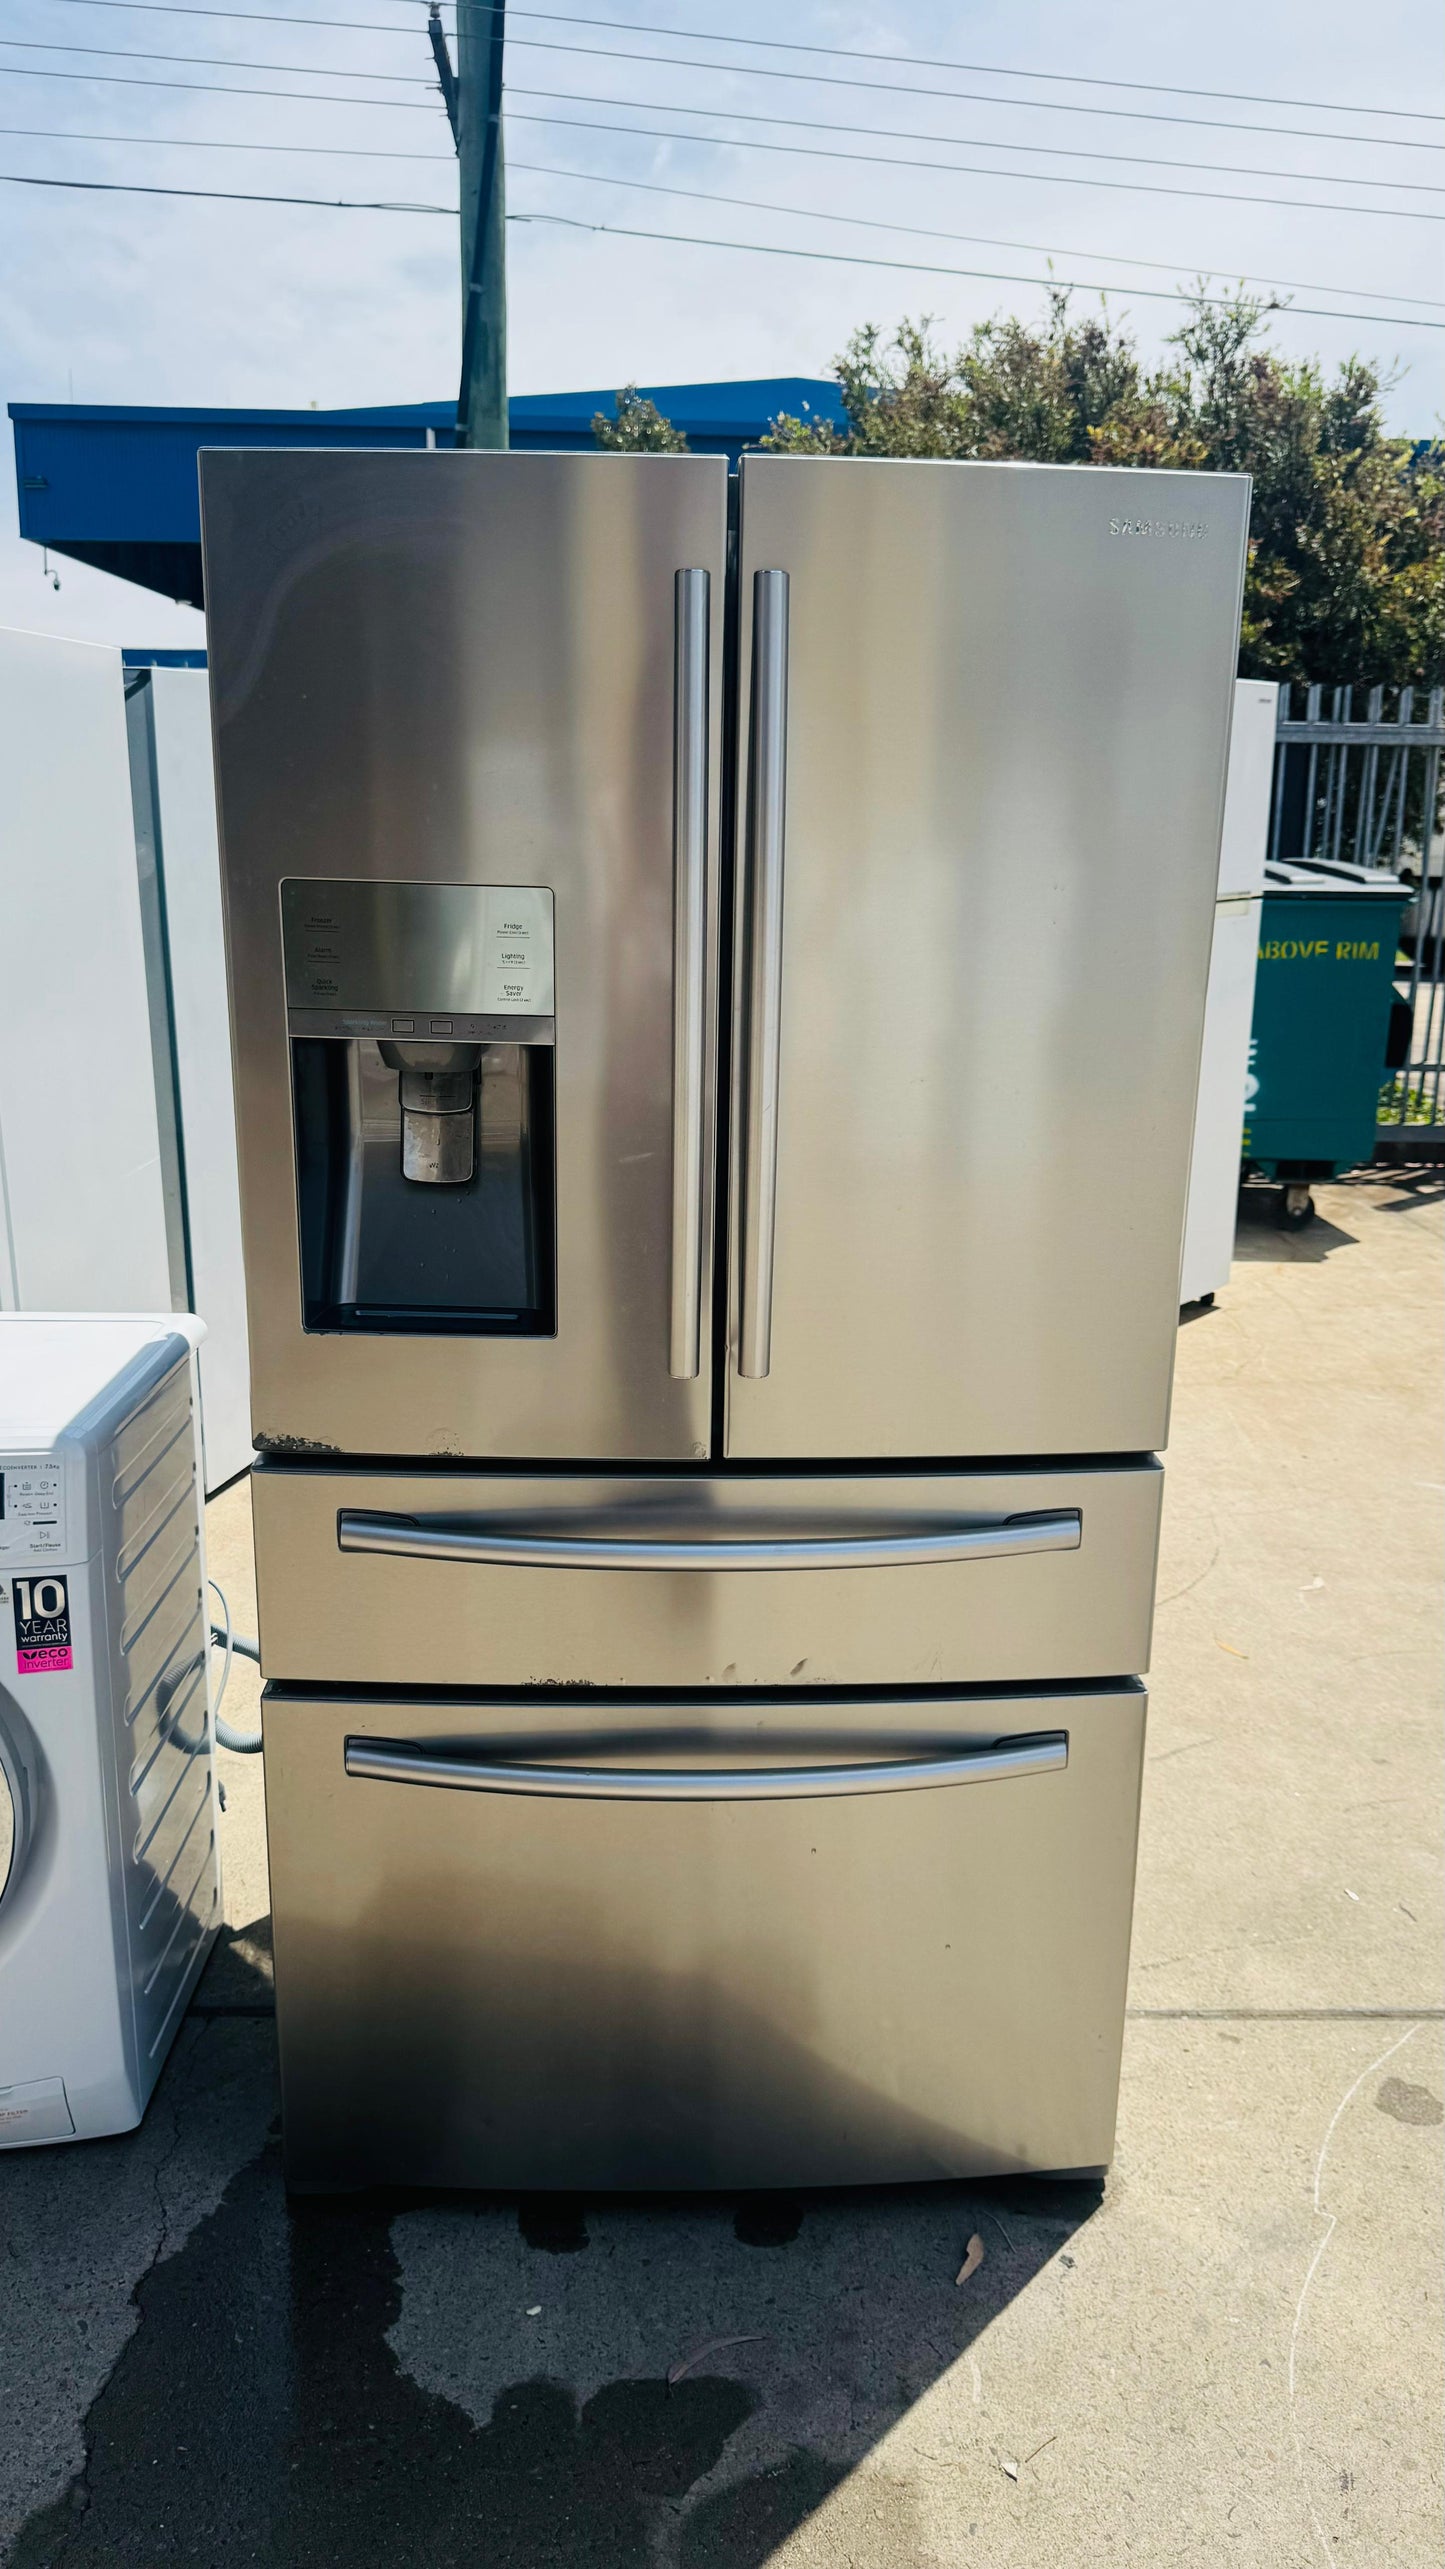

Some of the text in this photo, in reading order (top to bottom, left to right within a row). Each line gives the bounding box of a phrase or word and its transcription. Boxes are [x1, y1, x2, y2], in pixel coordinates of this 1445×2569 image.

[1335, 941, 1380, 960] RIM
[16, 1578, 66, 1620] 10
[19, 1618, 68, 1635] YEAR
[21, 1633, 68, 1643] warranty
[38, 1648, 68, 1659] eco
[24, 1658, 67, 1670] inverter
